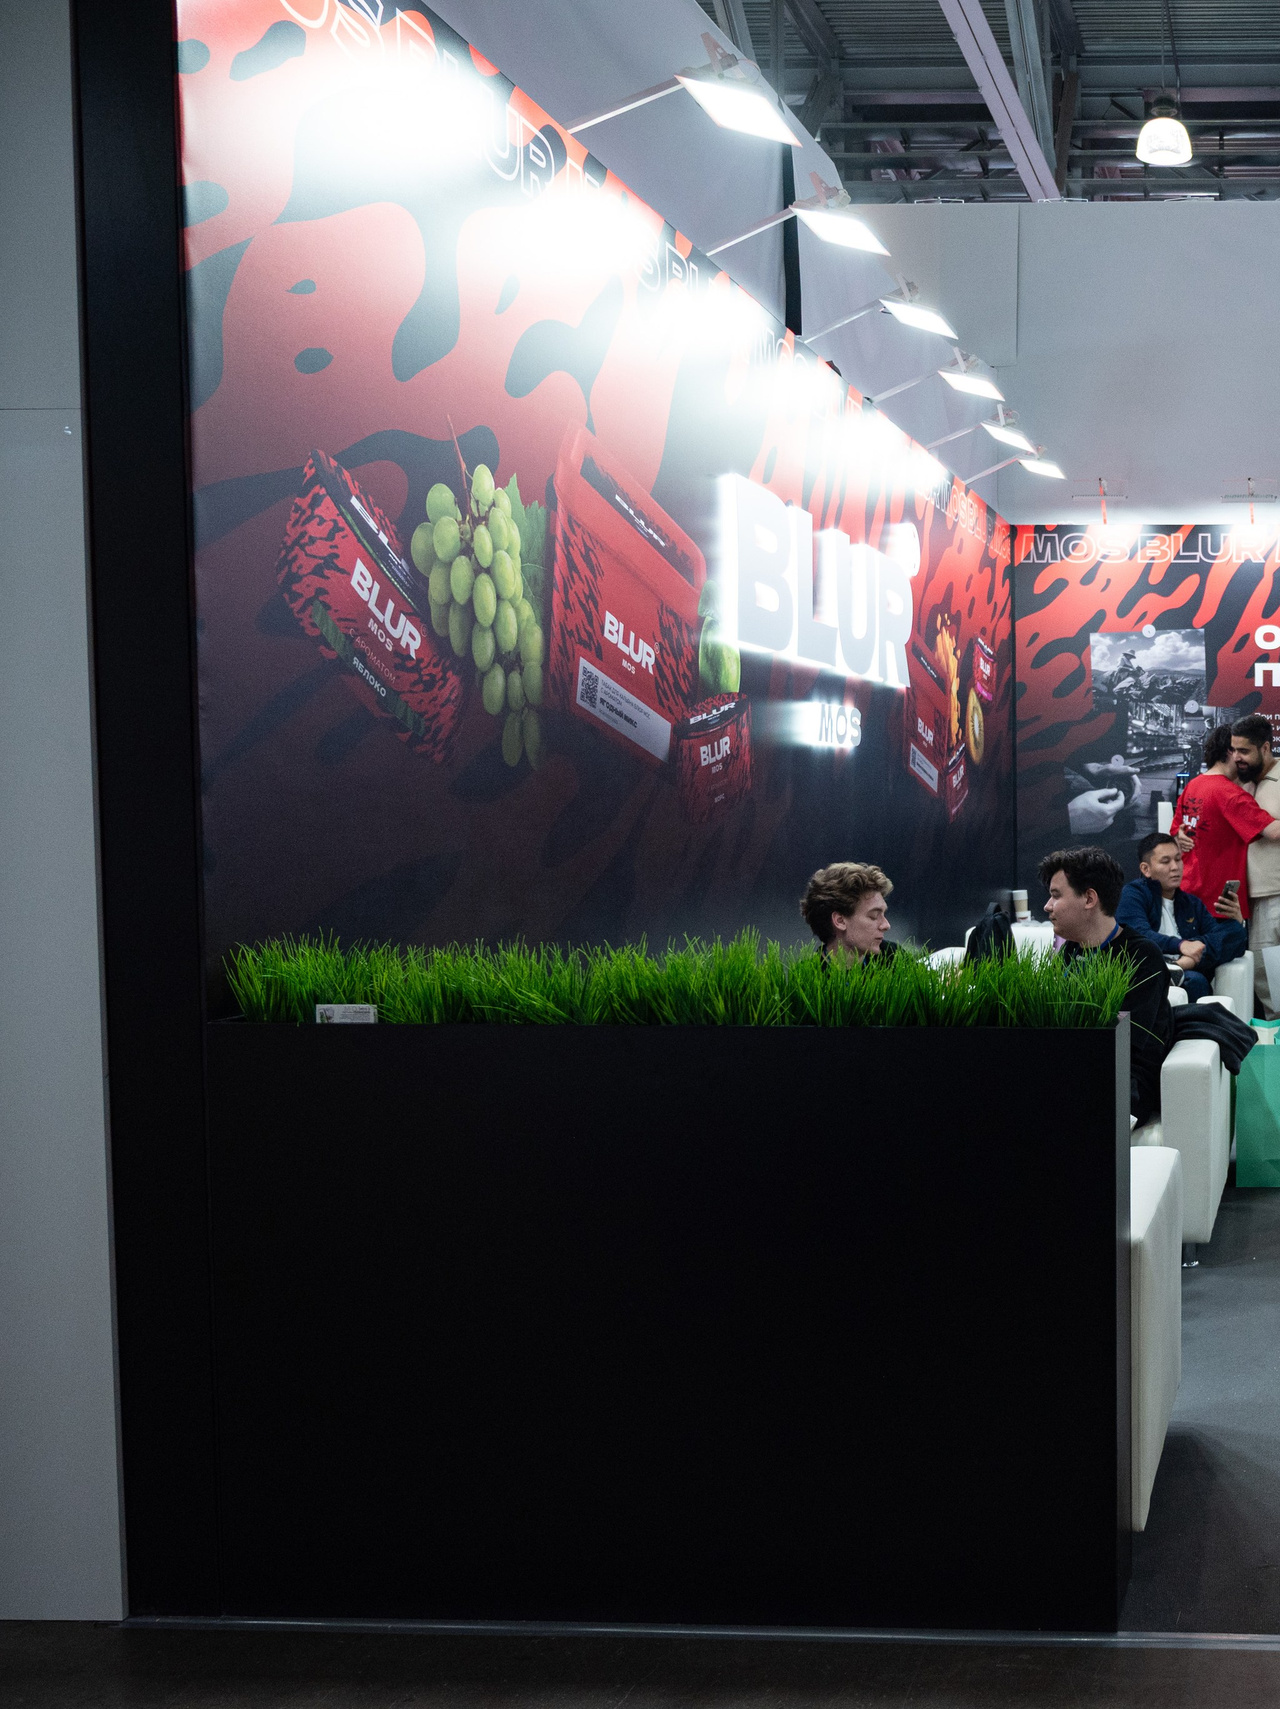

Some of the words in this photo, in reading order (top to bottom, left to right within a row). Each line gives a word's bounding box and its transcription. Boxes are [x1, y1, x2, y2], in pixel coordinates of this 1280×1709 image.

[1021, 533, 1131, 563] MOS
[1138, 533, 1265, 563] BLUR
[722, 472, 911, 688] BLUR
[351, 557, 422, 660] BLUR
[368, 618, 393, 652] MOS
[604, 610, 656, 675] BLUR
[352, 656, 387, 697] ЯБЛОКО
[355, 637, 397, 684] АРОМАТОМ
[622, 658, 636, 675] MOS
[689, 702, 736, 725] BLUR
[815, 701, 862, 748] MOS
[700, 736, 731, 767] BLUR
